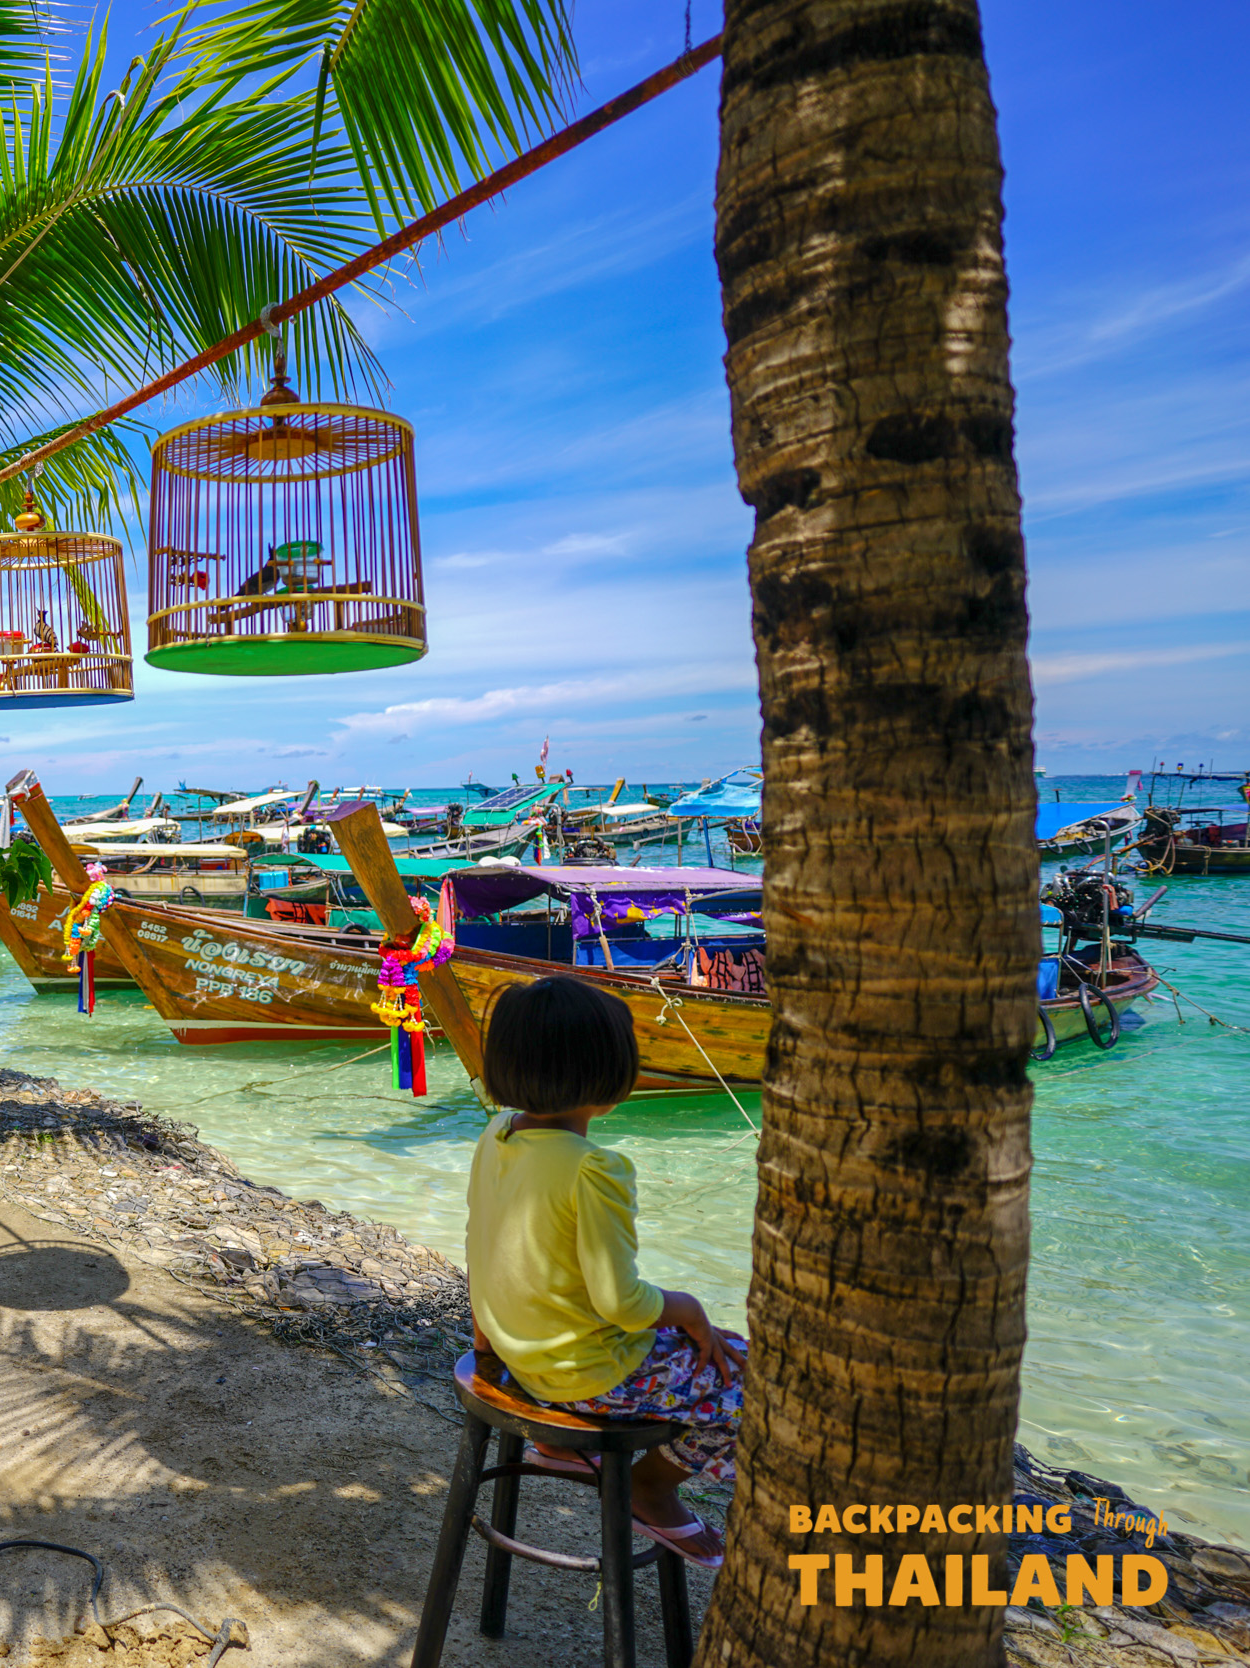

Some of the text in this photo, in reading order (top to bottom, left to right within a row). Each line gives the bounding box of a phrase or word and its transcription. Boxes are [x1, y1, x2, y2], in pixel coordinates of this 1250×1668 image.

[10, 907, 38, 922] 01644
[141, 921, 167, 934] 5452
[137, 929, 169, 943] 08517
[184, 958, 280, 988] NONGREYA
[195, 977, 235, 997] PPB
